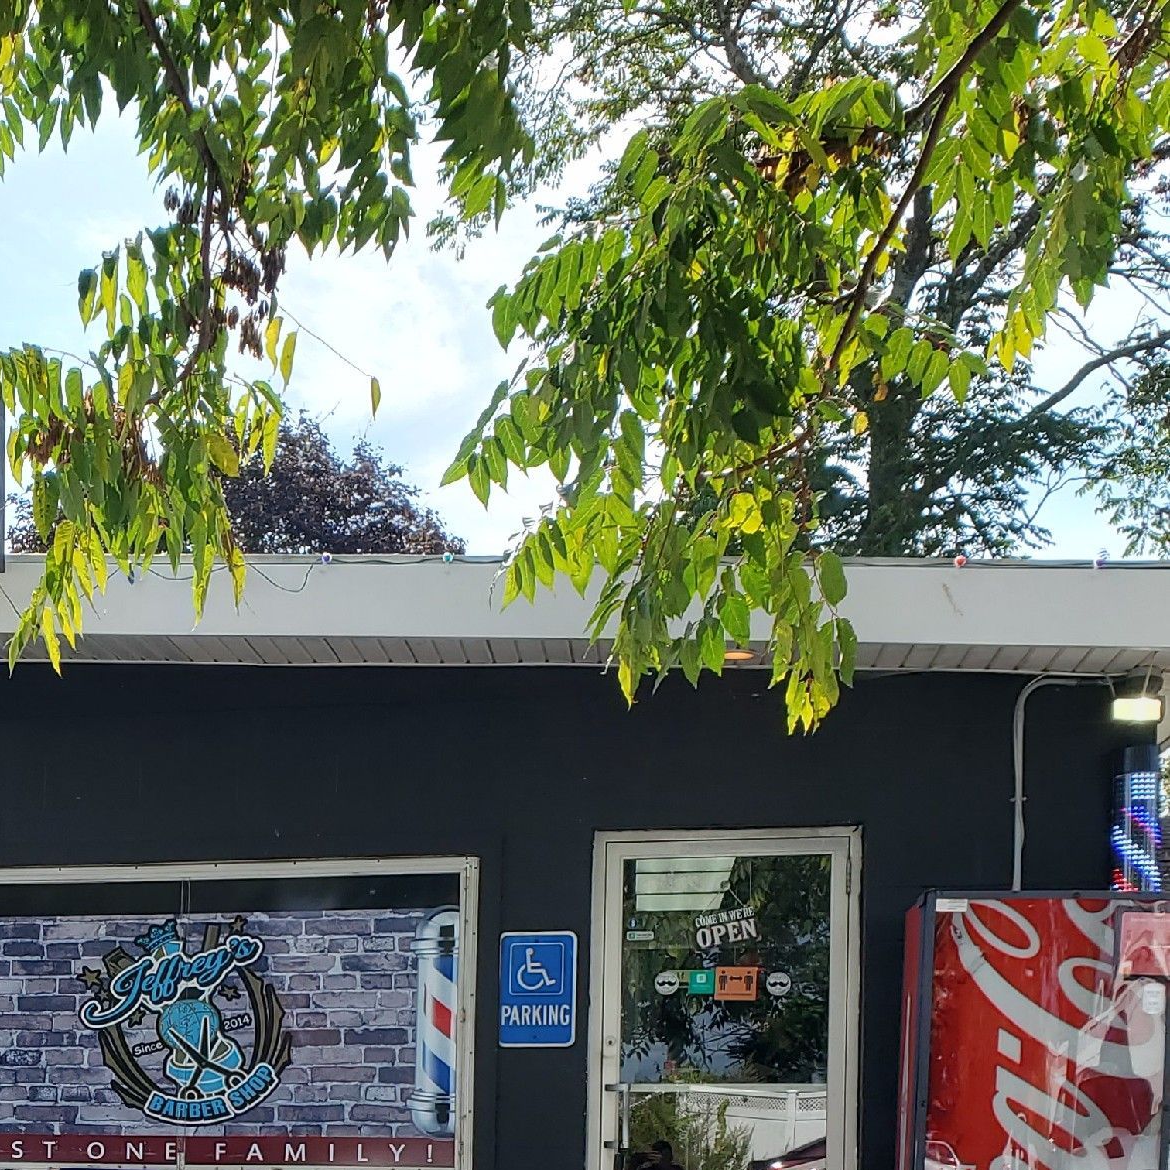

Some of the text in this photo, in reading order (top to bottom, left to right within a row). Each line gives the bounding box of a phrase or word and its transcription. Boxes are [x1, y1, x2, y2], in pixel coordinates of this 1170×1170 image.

[695, 913, 718, 928] COME
[718, 911, 728, 923] IN
[696, 918, 758, 949] OPEN
[81, 936, 261, 1027] Jeffrey's
[223, 1015, 251, 1030] 2014
[500, 1003, 571, 1027] PARKING
[134, 1043, 163, 1057] Since
[148, 1066, 274, 1119] BARBER SHOP
[86, 1141, 178, 1161] ONE
[215, 1143, 435, 1165] FAMILY!
